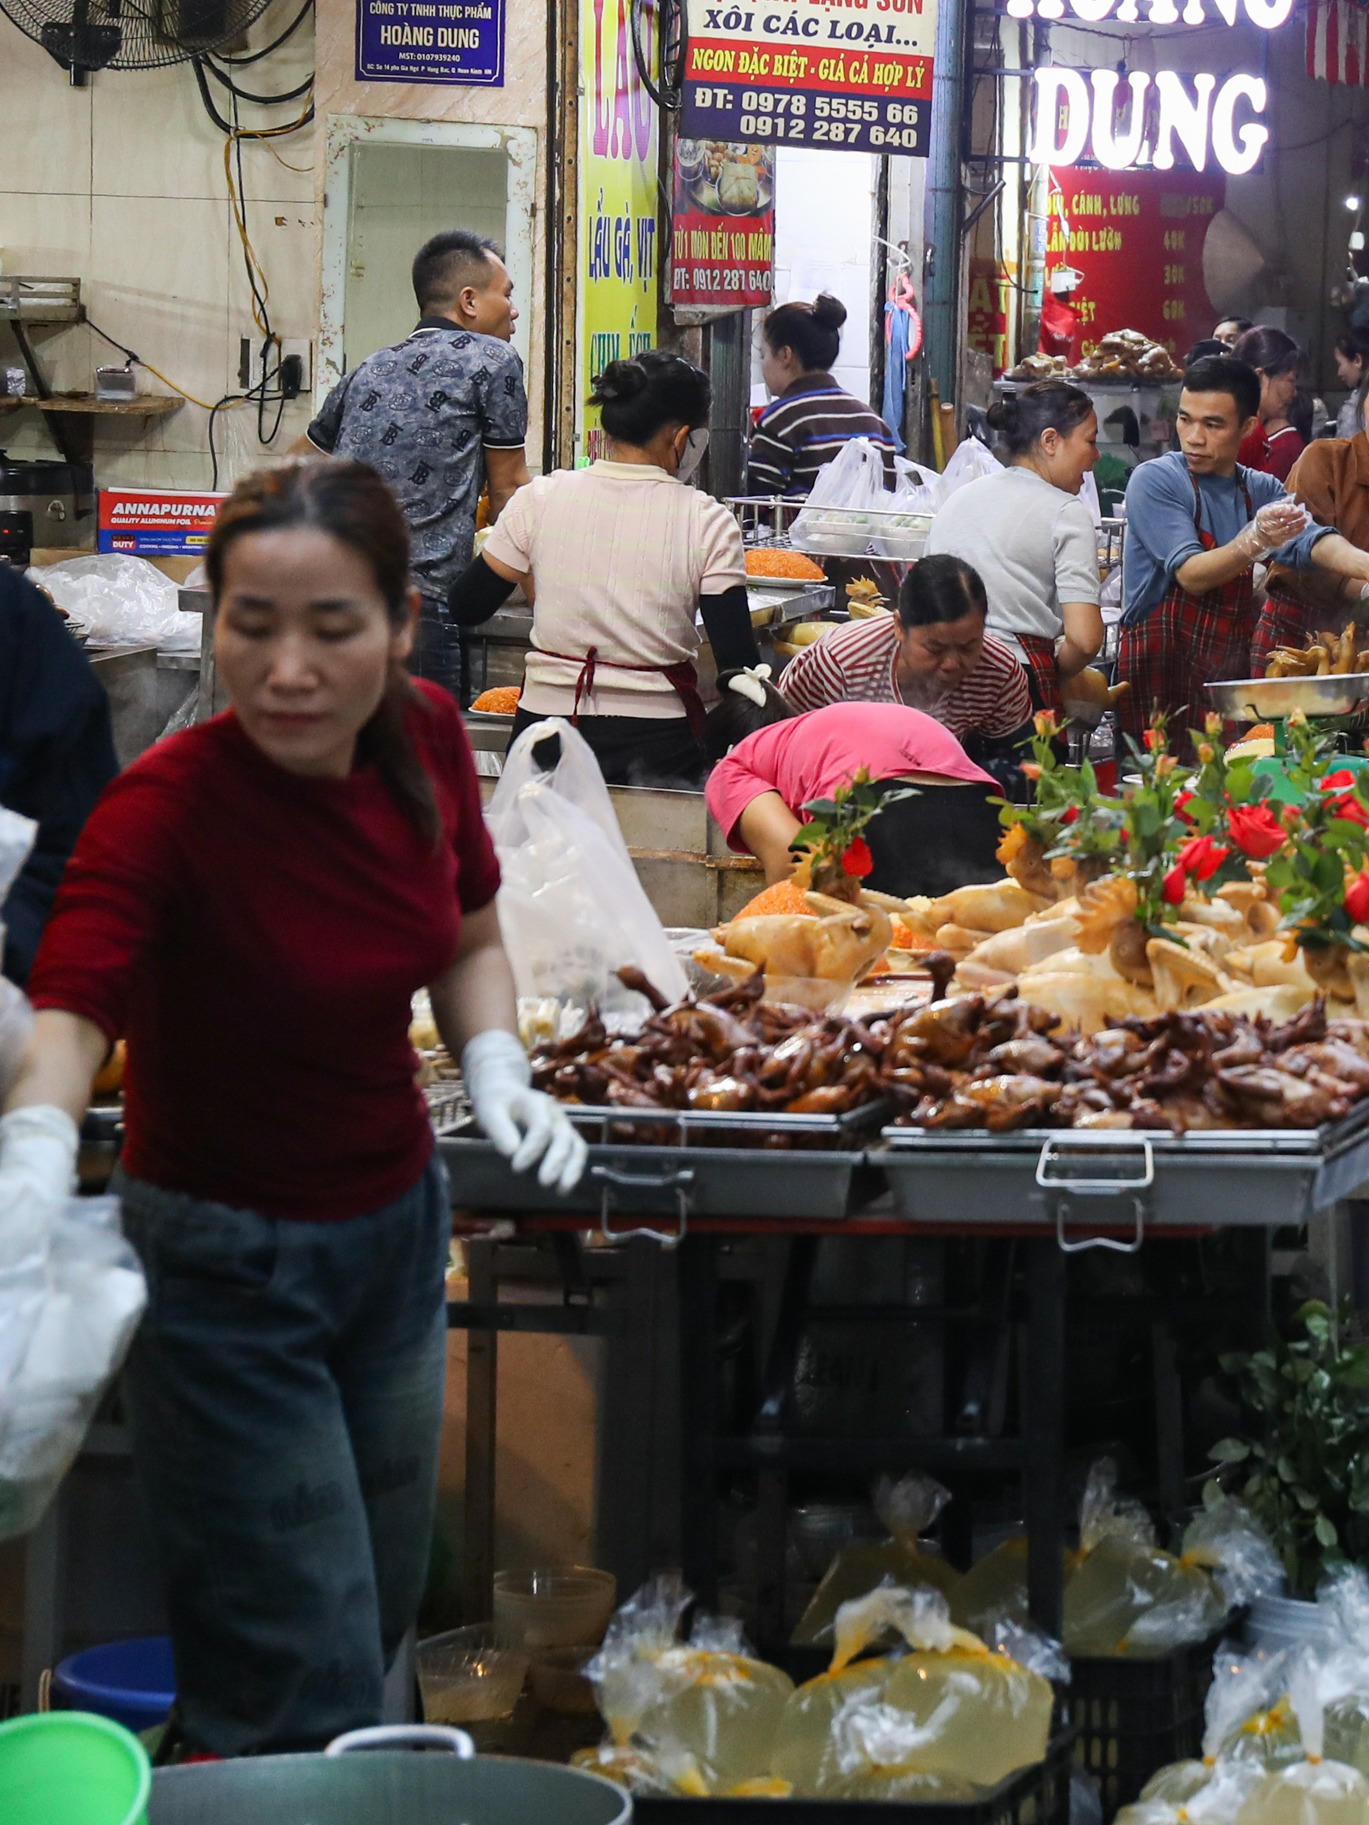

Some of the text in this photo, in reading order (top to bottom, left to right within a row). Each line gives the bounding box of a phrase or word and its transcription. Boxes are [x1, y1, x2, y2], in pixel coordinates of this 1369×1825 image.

[370, 0, 492, 20] CÔNG TY TNHH THỰC PHẨM
[380, 22, 480, 49] HOÀNG DUNG
[703, 5, 755, 32] XÔI
[762, 10, 820, 37] CÁC
[827, 20, 918, 49] LOẠI...
[399, 52, 416, 60] MST:
[692, 47, 736, 72] NGON
[738, 46, 769, 81] ĐẶC
[772, 49, 808, 84] BIỆT
[818, 53, 846, 82] GIÁ
[849, 54, 869, 83] CẢ
[872, 60, 903, 92] HỢP
[905, 60, 926, 88] LÝ
[694, 88, 919, 125] ĐT: 0978 5555 66
[739, 116, 918, 148] 0912 287 640
[1030, 67, 1268, 175] DUNG
[588, 186, 611, 284] LẨU
[636, 216, 655, 293] VỊT
[731, 233, 746, 261] 100
[673, 268, 772, 292] ĐT: 0912 287 640
[112, 503, 216, 517] ANNAPURNA
[112, 541, 134, 549] DUTY
